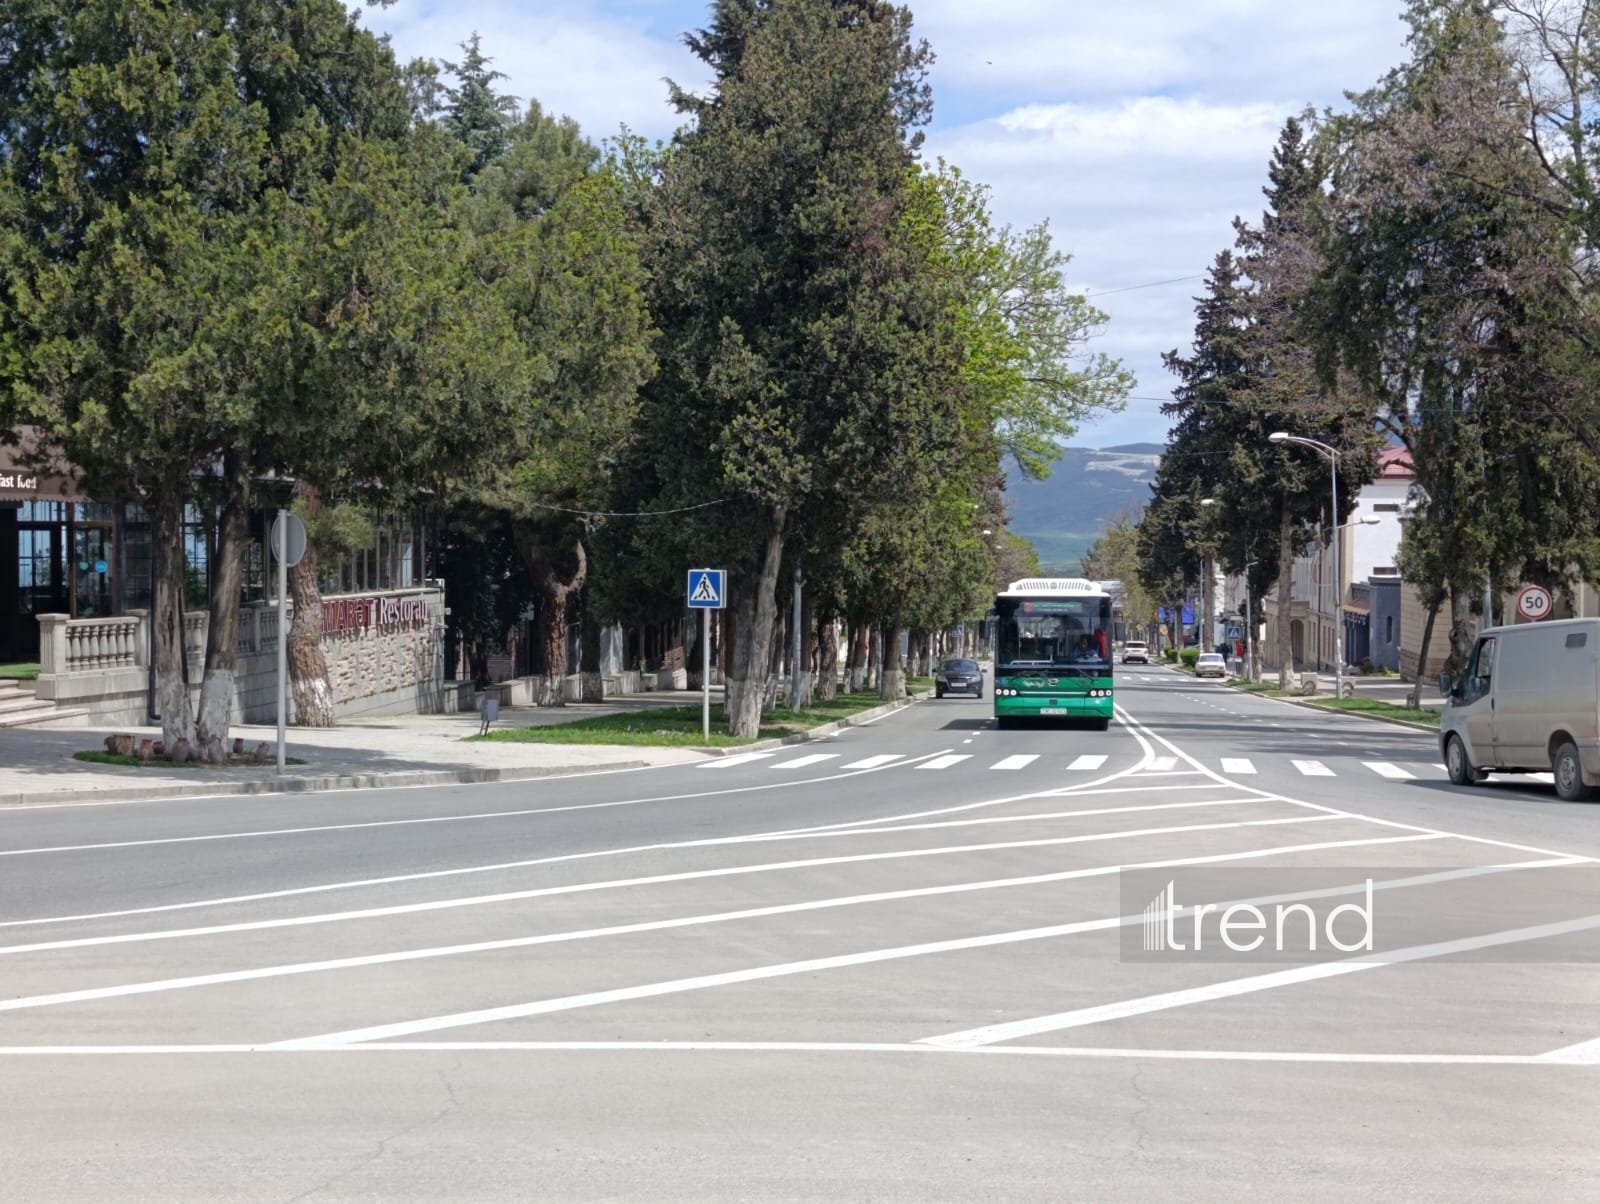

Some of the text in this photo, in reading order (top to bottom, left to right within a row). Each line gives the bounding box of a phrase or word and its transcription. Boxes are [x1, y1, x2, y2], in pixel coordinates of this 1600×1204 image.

[17, 474, 37, 489] food
[1525, 596, 1544, 609] 50
[320, 597, 428, 633] MARƏT Restoran
